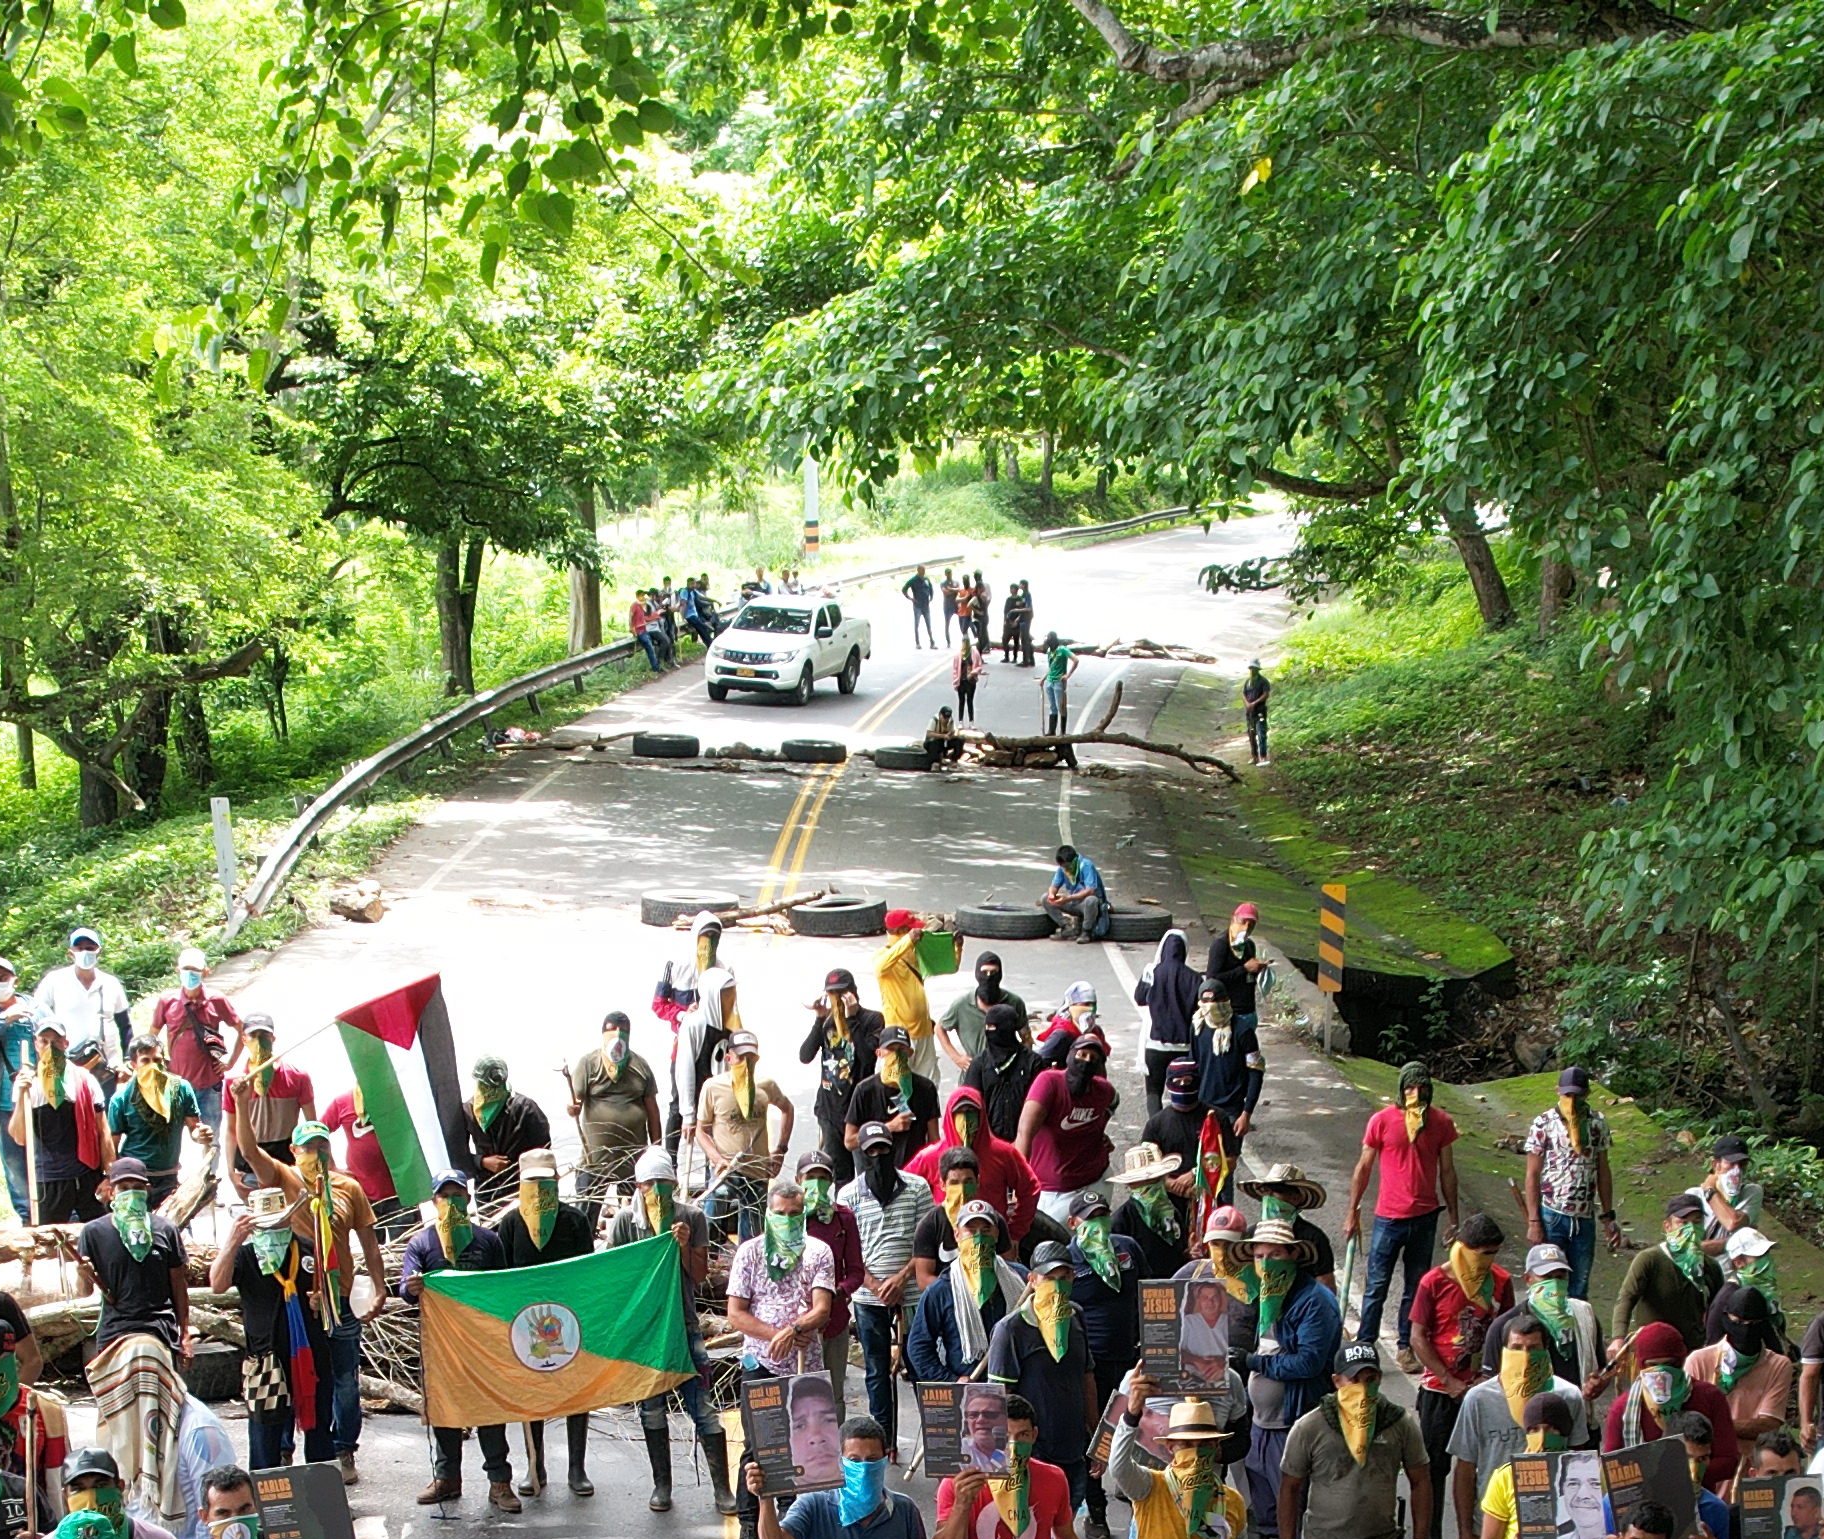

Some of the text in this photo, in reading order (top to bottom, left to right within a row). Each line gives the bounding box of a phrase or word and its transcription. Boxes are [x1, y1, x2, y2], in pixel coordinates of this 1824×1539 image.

[1070, 1108, 1095, 1120] NIKE
[1143, 1298, 1176, 1313] JESUS
[1345, 1346, 1376, 1361] BOSS
[922, 1389, 953, 1401] JAIME
[1517, 1469, 1550, 1486] JESUS
[257, 1477, 292, 1494] CARLOS
